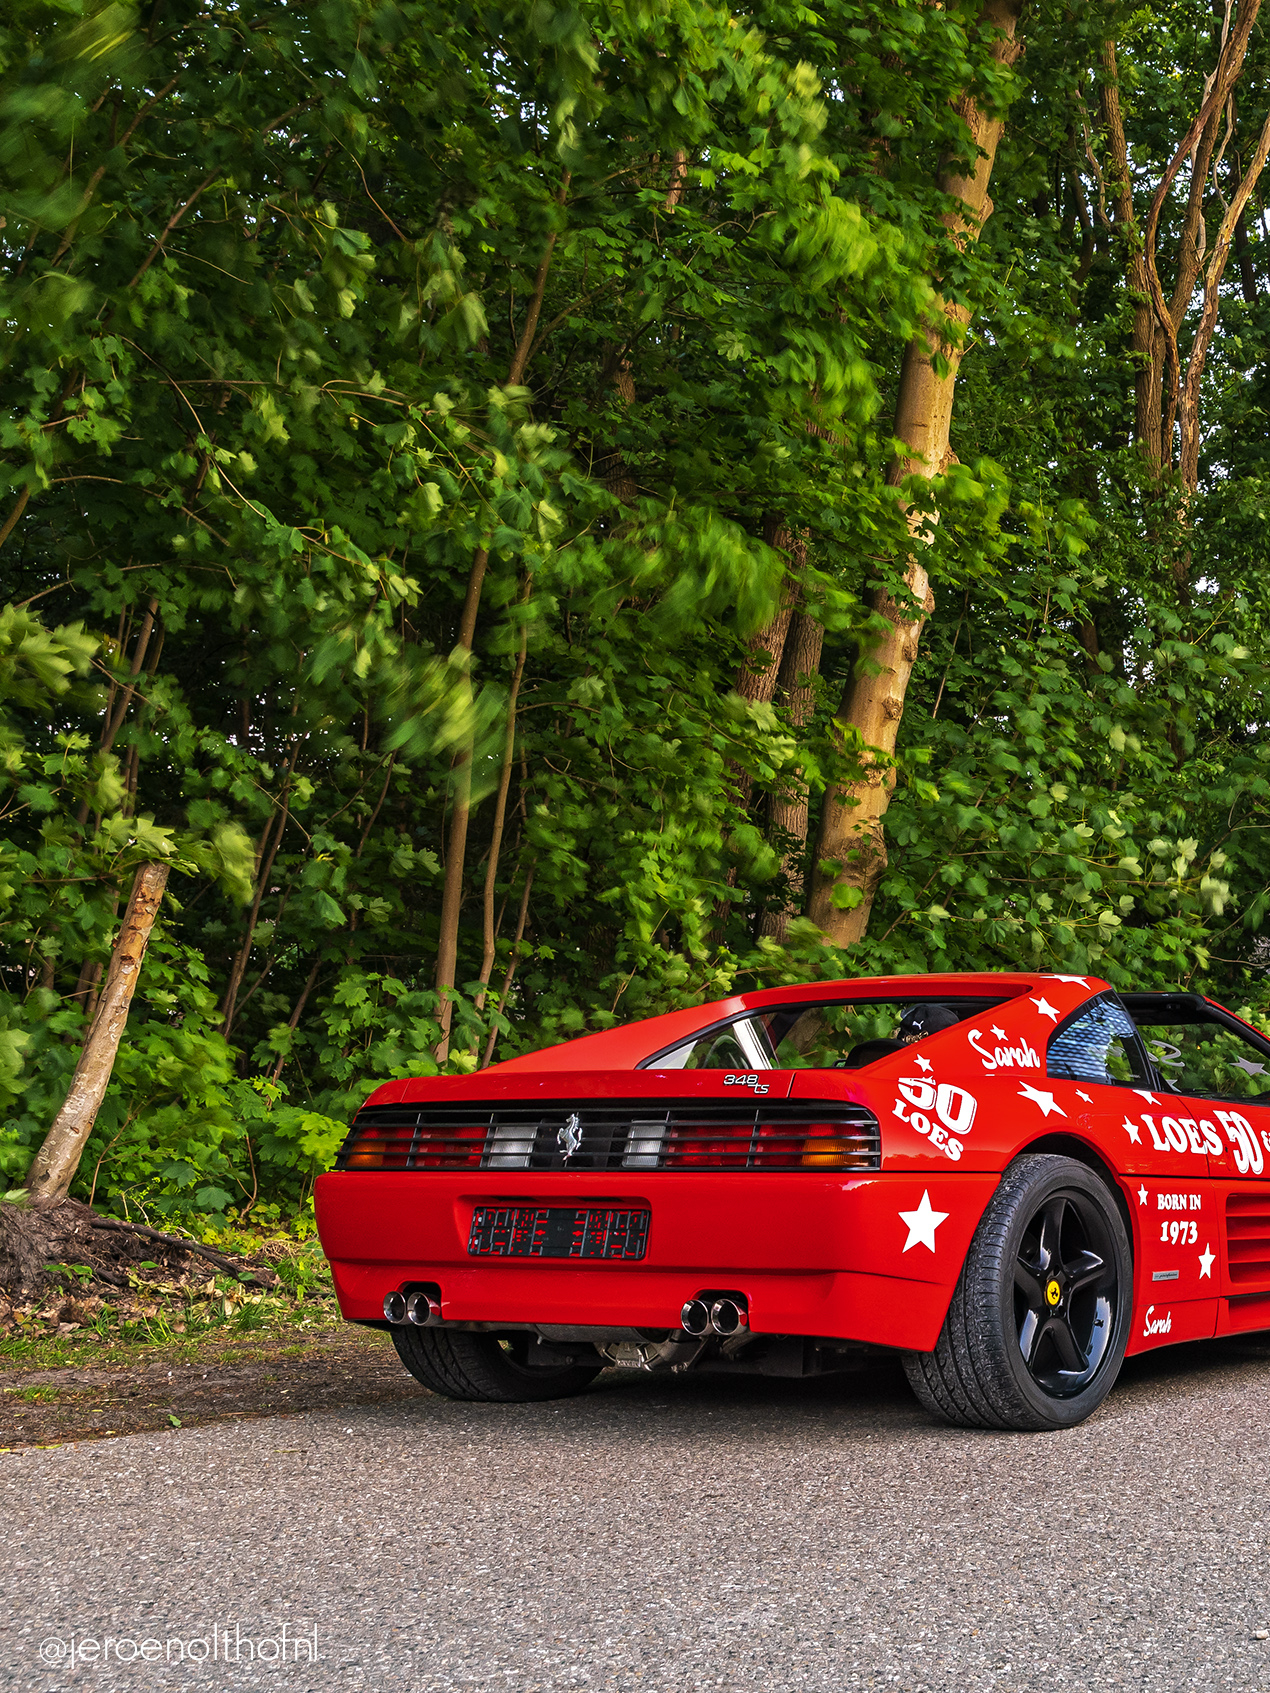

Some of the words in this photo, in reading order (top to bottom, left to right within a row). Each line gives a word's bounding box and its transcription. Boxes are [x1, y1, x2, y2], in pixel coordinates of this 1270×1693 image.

[967, 1029, 1041, 1070] Sarah
[723, 1074, 759, 1086] 348
[898, 1076, 977, 1135] 50
[891, 1099, 964, 1161] LOES
[1140, 1114, 1223, 1156] LOES
[1213, 1110, 1264, 1175] 50
[1157, 1193, 1187, 1210] BORN
[1189, 1194, 1202, 1210] IN
[1159, 1220, 1199, 1246] 1973
[1142, 1305, 1172, 1337] Sarah
